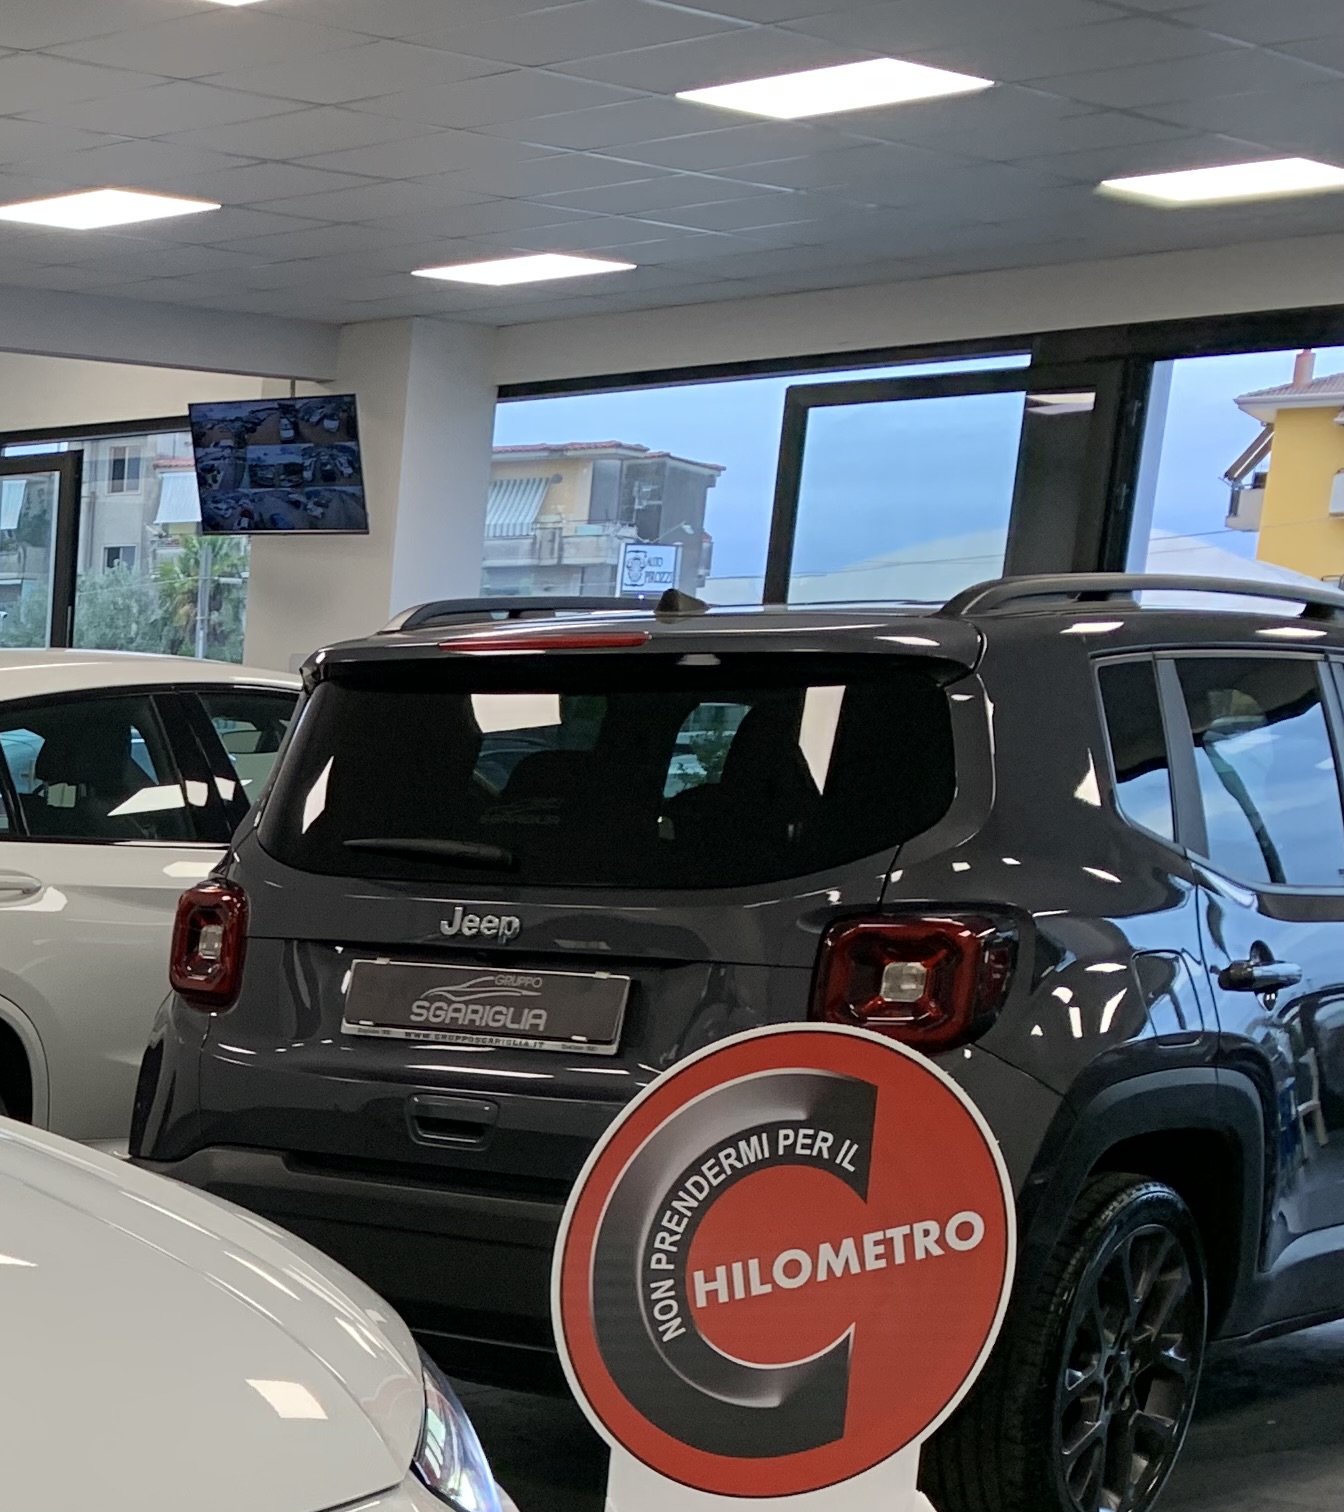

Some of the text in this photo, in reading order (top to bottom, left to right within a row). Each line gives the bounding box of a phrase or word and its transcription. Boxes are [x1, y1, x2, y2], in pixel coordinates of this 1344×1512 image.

[439, 906, 521, 944] Jeep
[494, 974, 543, 989] GRUPPO
[410, 1000, 548, 1031] SGARIGLIA
[650, 1128, 859, 1343] NON PRENDERMI PER IL
